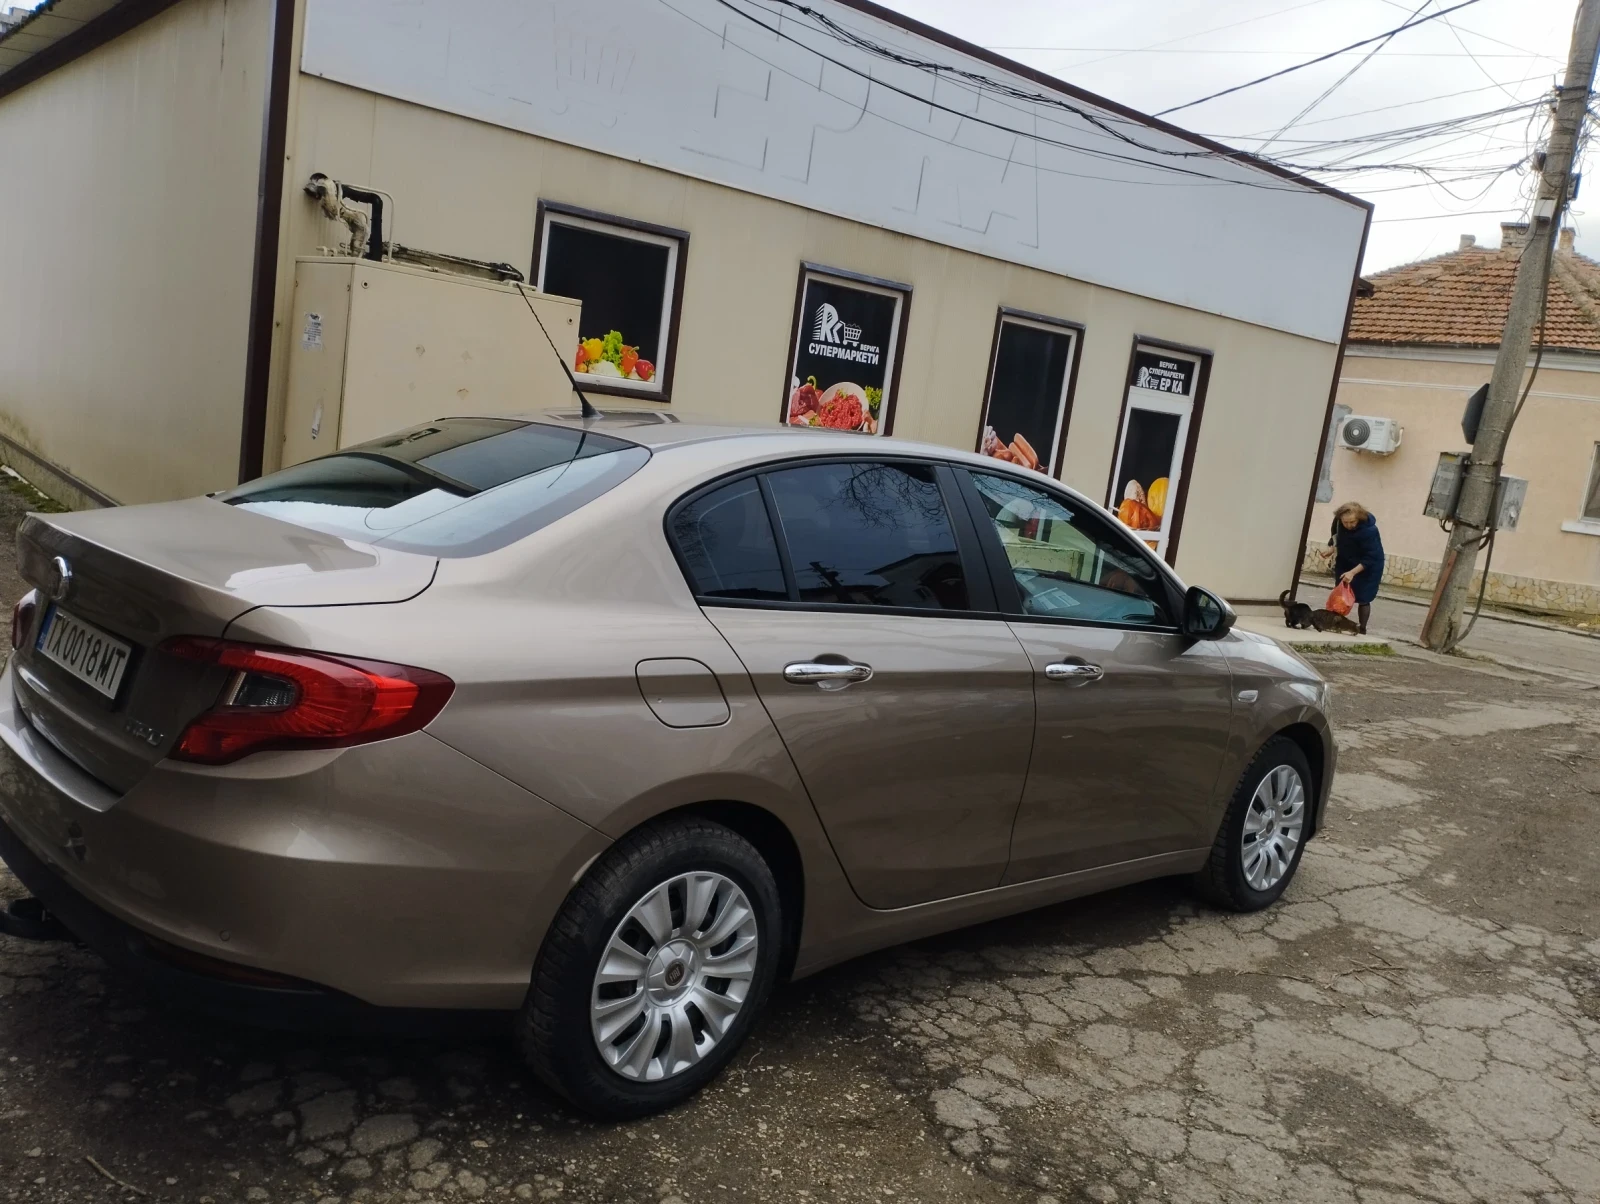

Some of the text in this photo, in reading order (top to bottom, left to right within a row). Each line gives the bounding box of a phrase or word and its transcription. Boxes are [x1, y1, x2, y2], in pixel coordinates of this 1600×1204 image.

[808, 342, 879, 365] СУПЕРМАРКЕТИ
[860, 343, 879, 353] ВЕРИГА
[1149, 367, 1185, 379] СУПЕРМАРКЕТИ
